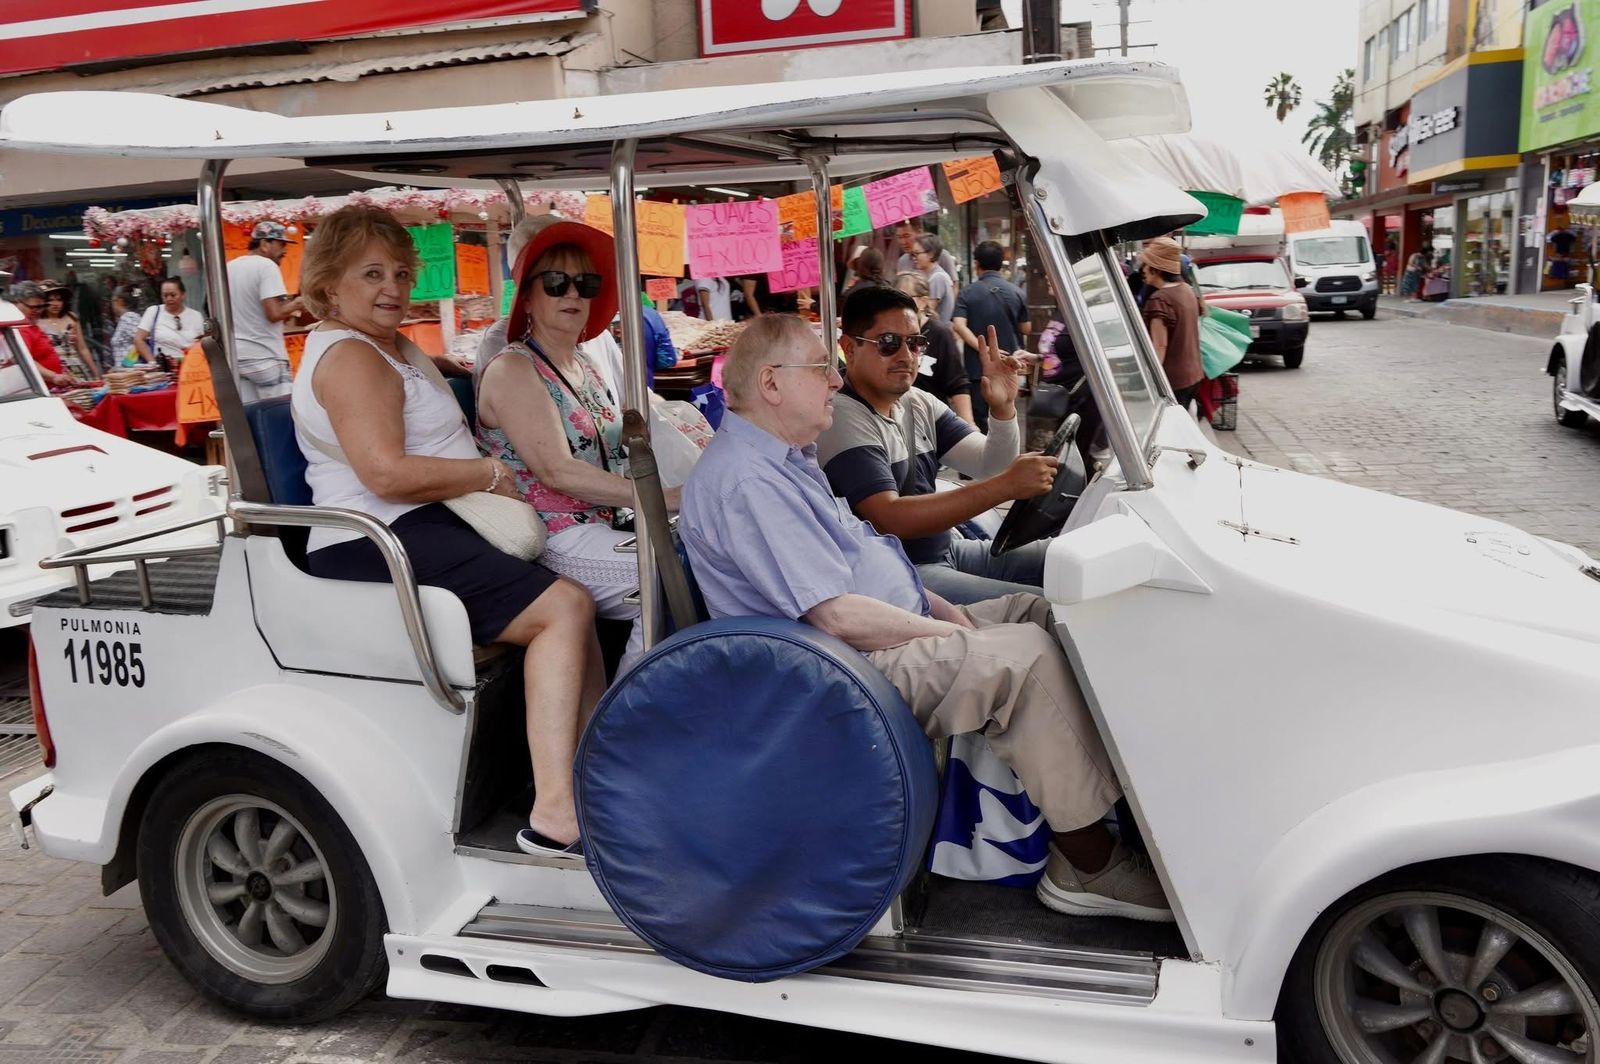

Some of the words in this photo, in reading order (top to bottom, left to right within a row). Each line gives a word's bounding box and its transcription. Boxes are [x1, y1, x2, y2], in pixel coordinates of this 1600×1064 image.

[696, 202, 773, 226] SUAVES
[60, 617, 142, 636] PULMONIA
[63, 637, 146, 689] 11985
